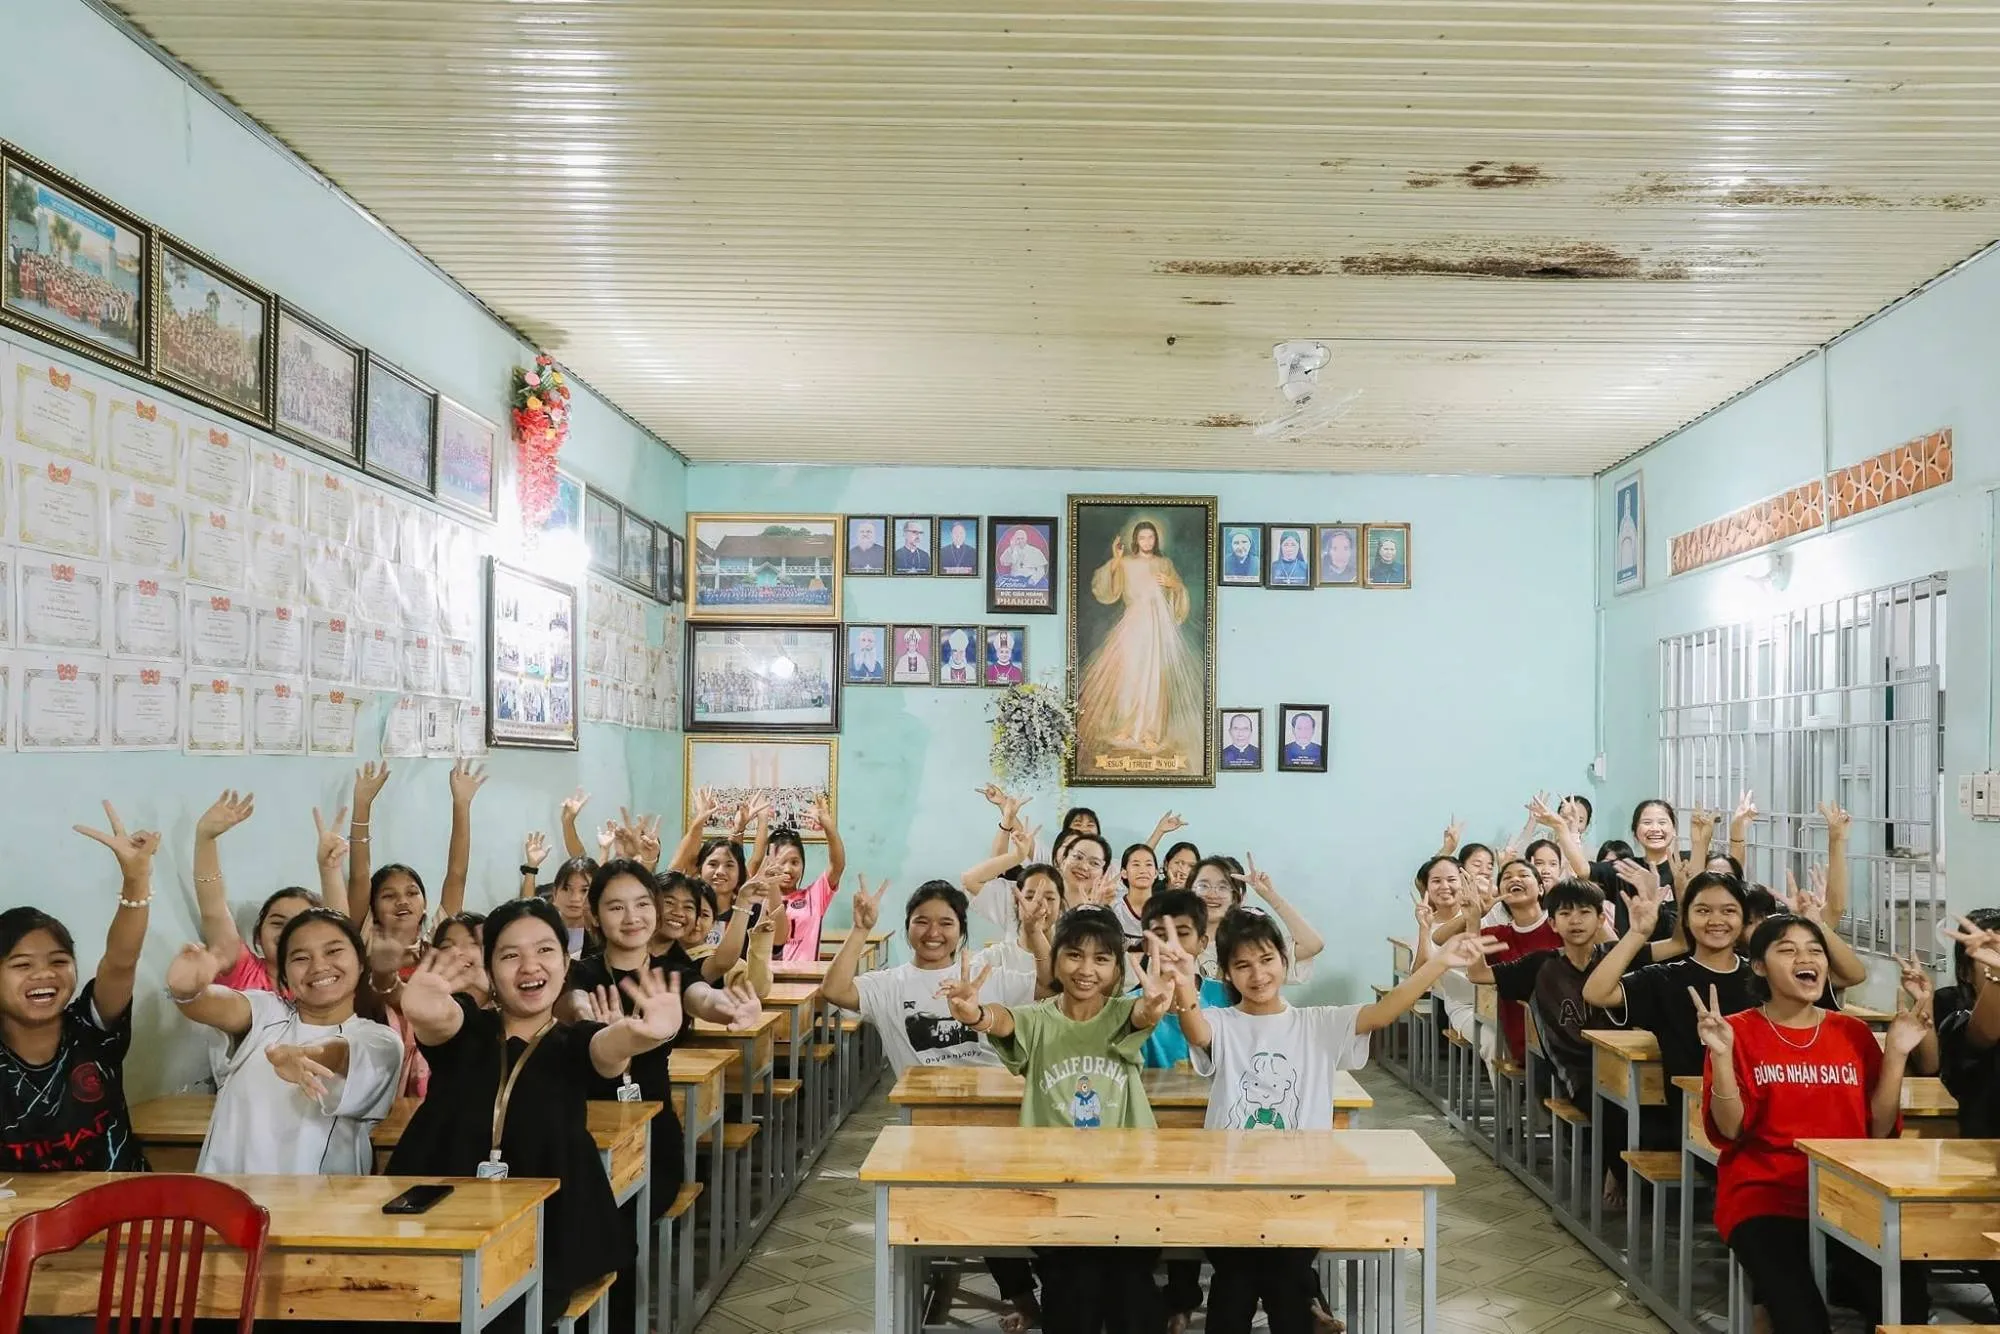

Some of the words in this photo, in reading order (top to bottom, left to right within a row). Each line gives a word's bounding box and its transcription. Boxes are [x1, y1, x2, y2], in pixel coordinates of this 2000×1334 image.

[1754, 1061, 1785, 1086] ĐÚNG
[1786, 1061, 1818, 1088] NHẬN
[1820, 1064, 1840, 1084] SAI
